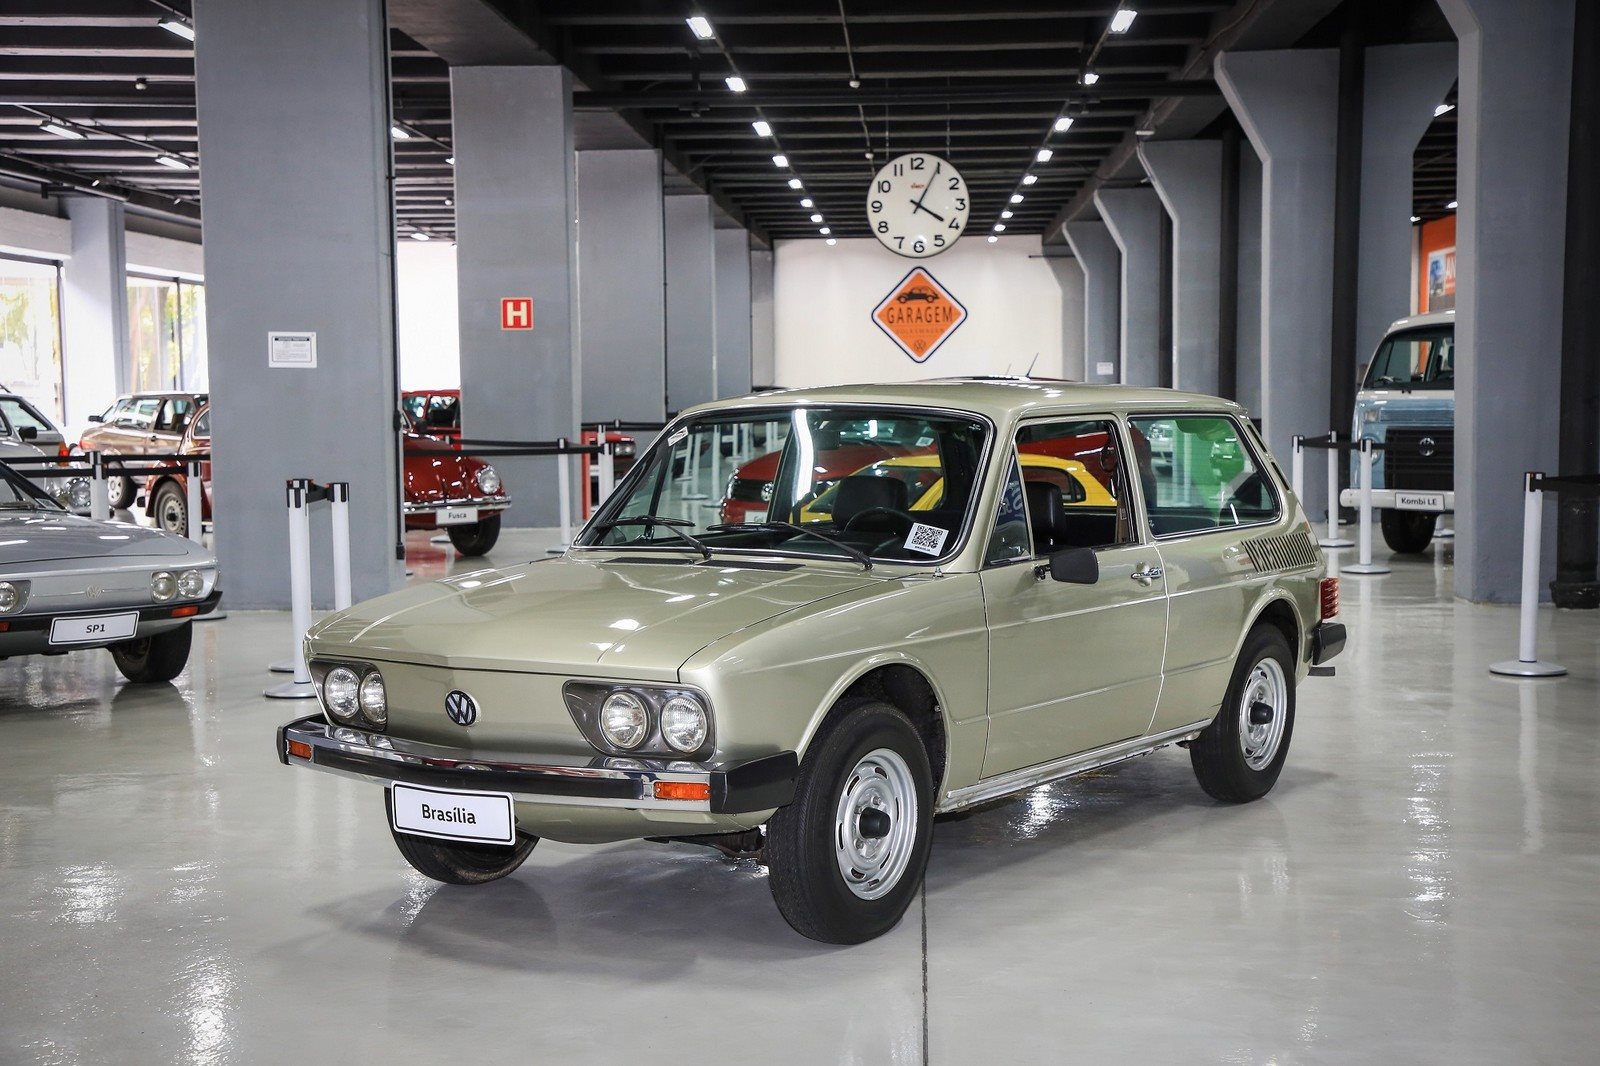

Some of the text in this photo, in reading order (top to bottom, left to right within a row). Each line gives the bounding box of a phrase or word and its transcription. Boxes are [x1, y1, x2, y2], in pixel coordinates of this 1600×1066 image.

[894, 163, 904, 177] 11
[910, 157, 925, 171] 12
[936, 161, 941, 175] 1
[877, 180, 891, 194] 10
[948, 177, 960, 191] 2
[871, 200, 883, 213] 9
[955, 198, 966, 211] 3
[877, 220, 889, 234] 8
[948, 217, 960, 231] 4
[893, 236, 905, 249] 7
[913, 240, 925, 253] 6
[934, 234, 945, 247] 5
[506, 301, 528, 327] H
[886, 306, 953, 323] GARAGEM
[1401, 497, 1438, 506] Kombi LE
[86, 624, 105, 633] SP1
[421, 803, 477, 825] Brasília
